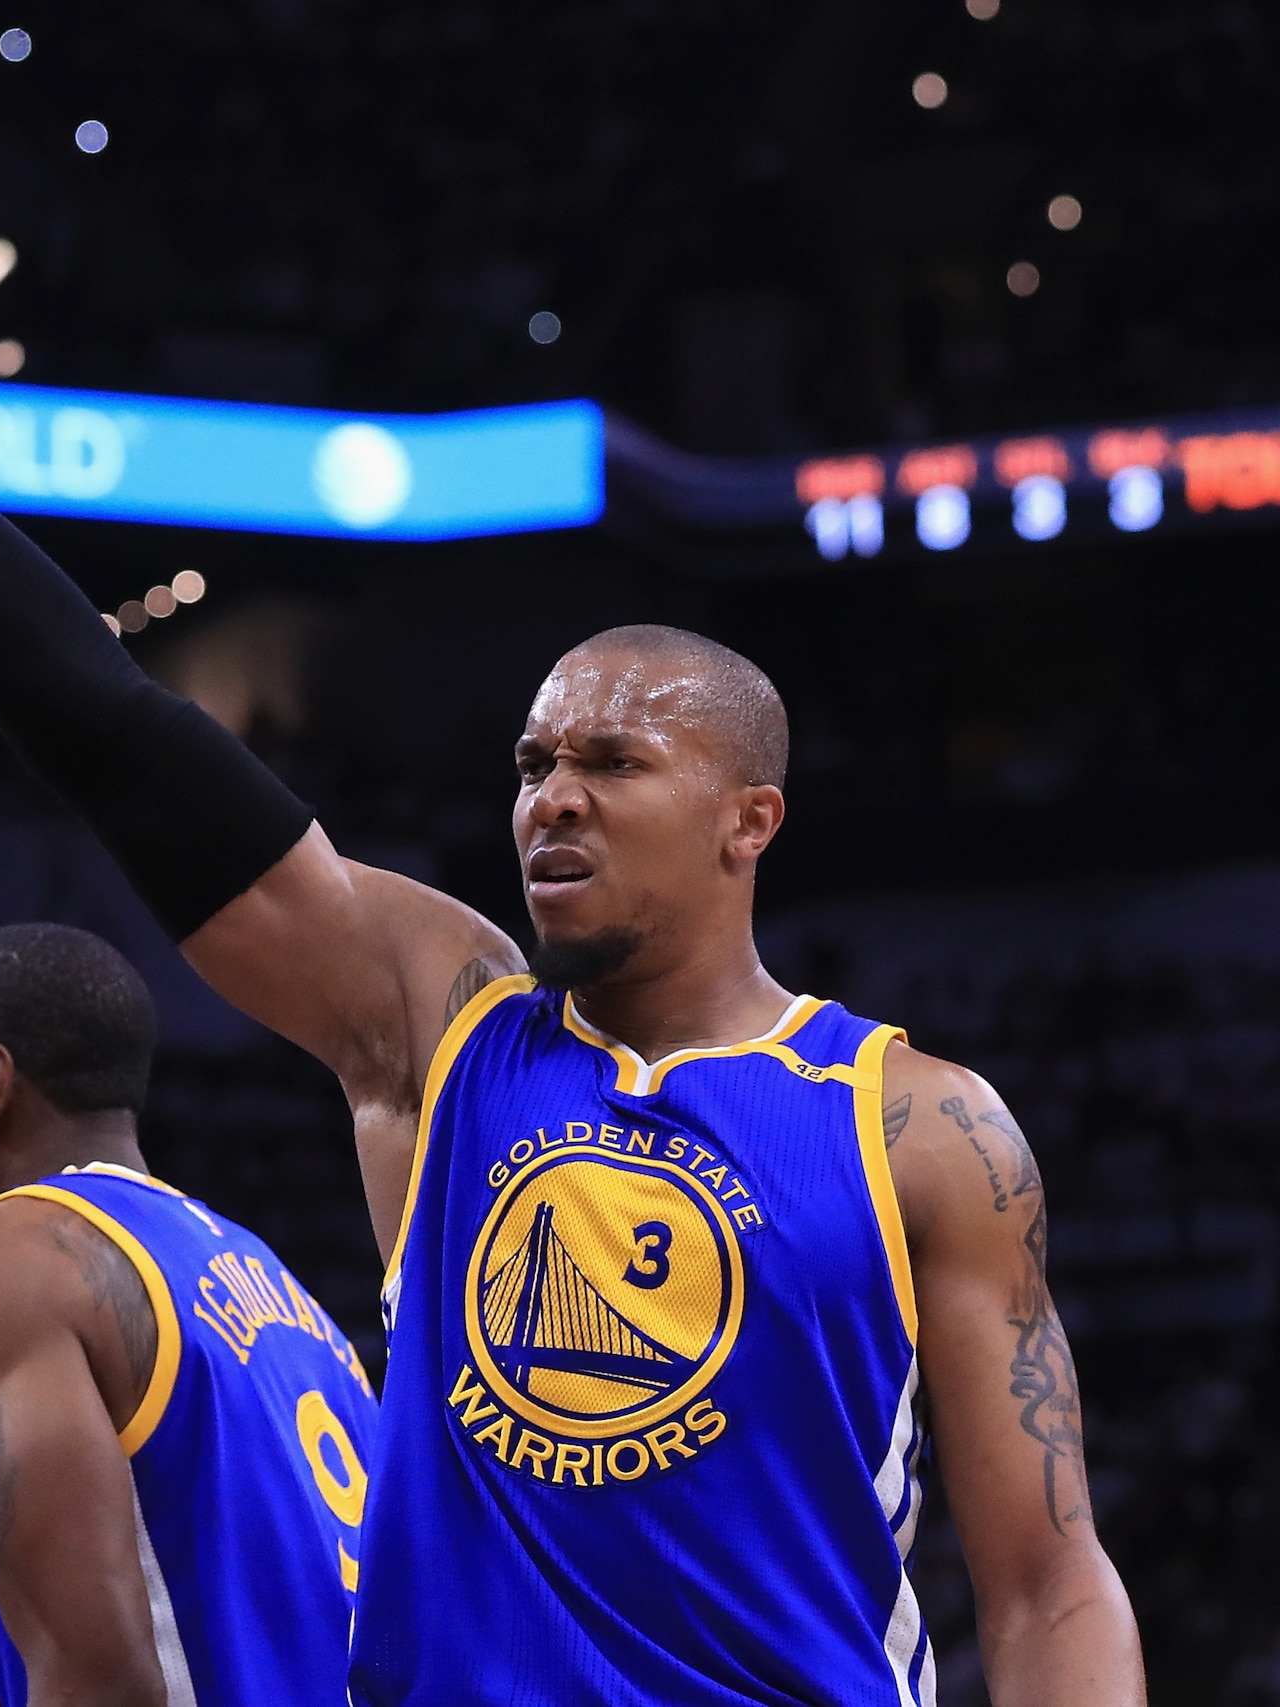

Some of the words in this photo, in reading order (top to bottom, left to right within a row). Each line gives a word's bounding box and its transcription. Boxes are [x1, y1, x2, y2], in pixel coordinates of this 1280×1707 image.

[796, 1064, 823, 1080] 42
[486, 1121, 656, 1189] GOLDEN
[664, 1136, 764, 1232] STATE
[622, 1220, 673, 1291] 3
[447, 1364, 729, 1488] WARRIORS
